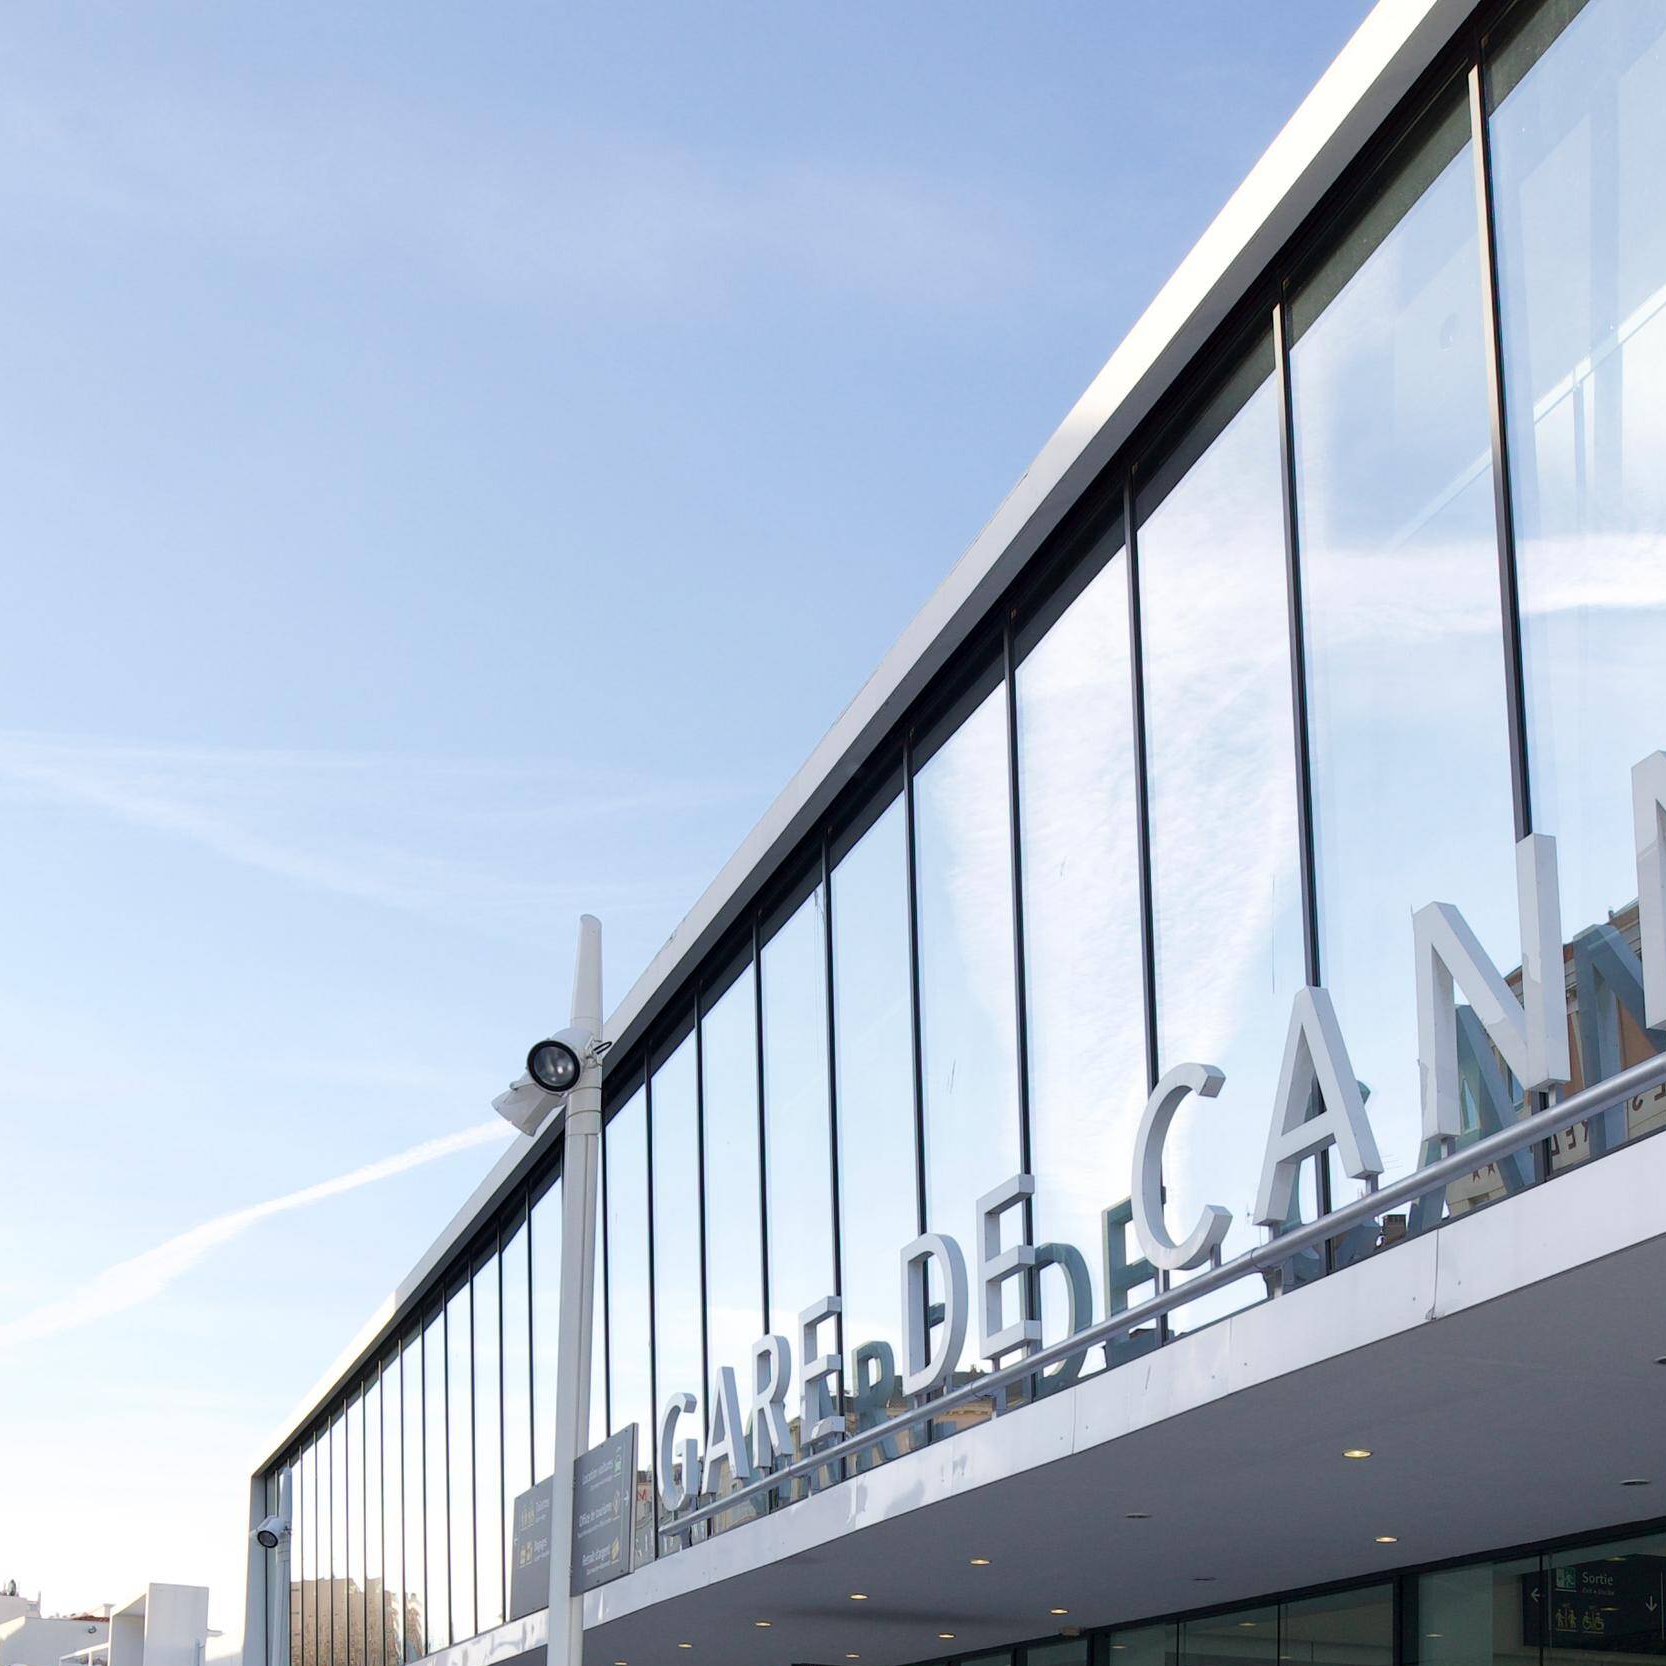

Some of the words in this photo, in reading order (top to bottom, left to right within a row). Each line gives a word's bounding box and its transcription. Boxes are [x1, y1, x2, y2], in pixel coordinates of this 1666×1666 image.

[657, 1295, 845, 1512] GARE
[900, 1173, 1041, 1397] DE
[1582, 1572, 1614, 1586] Sortie
